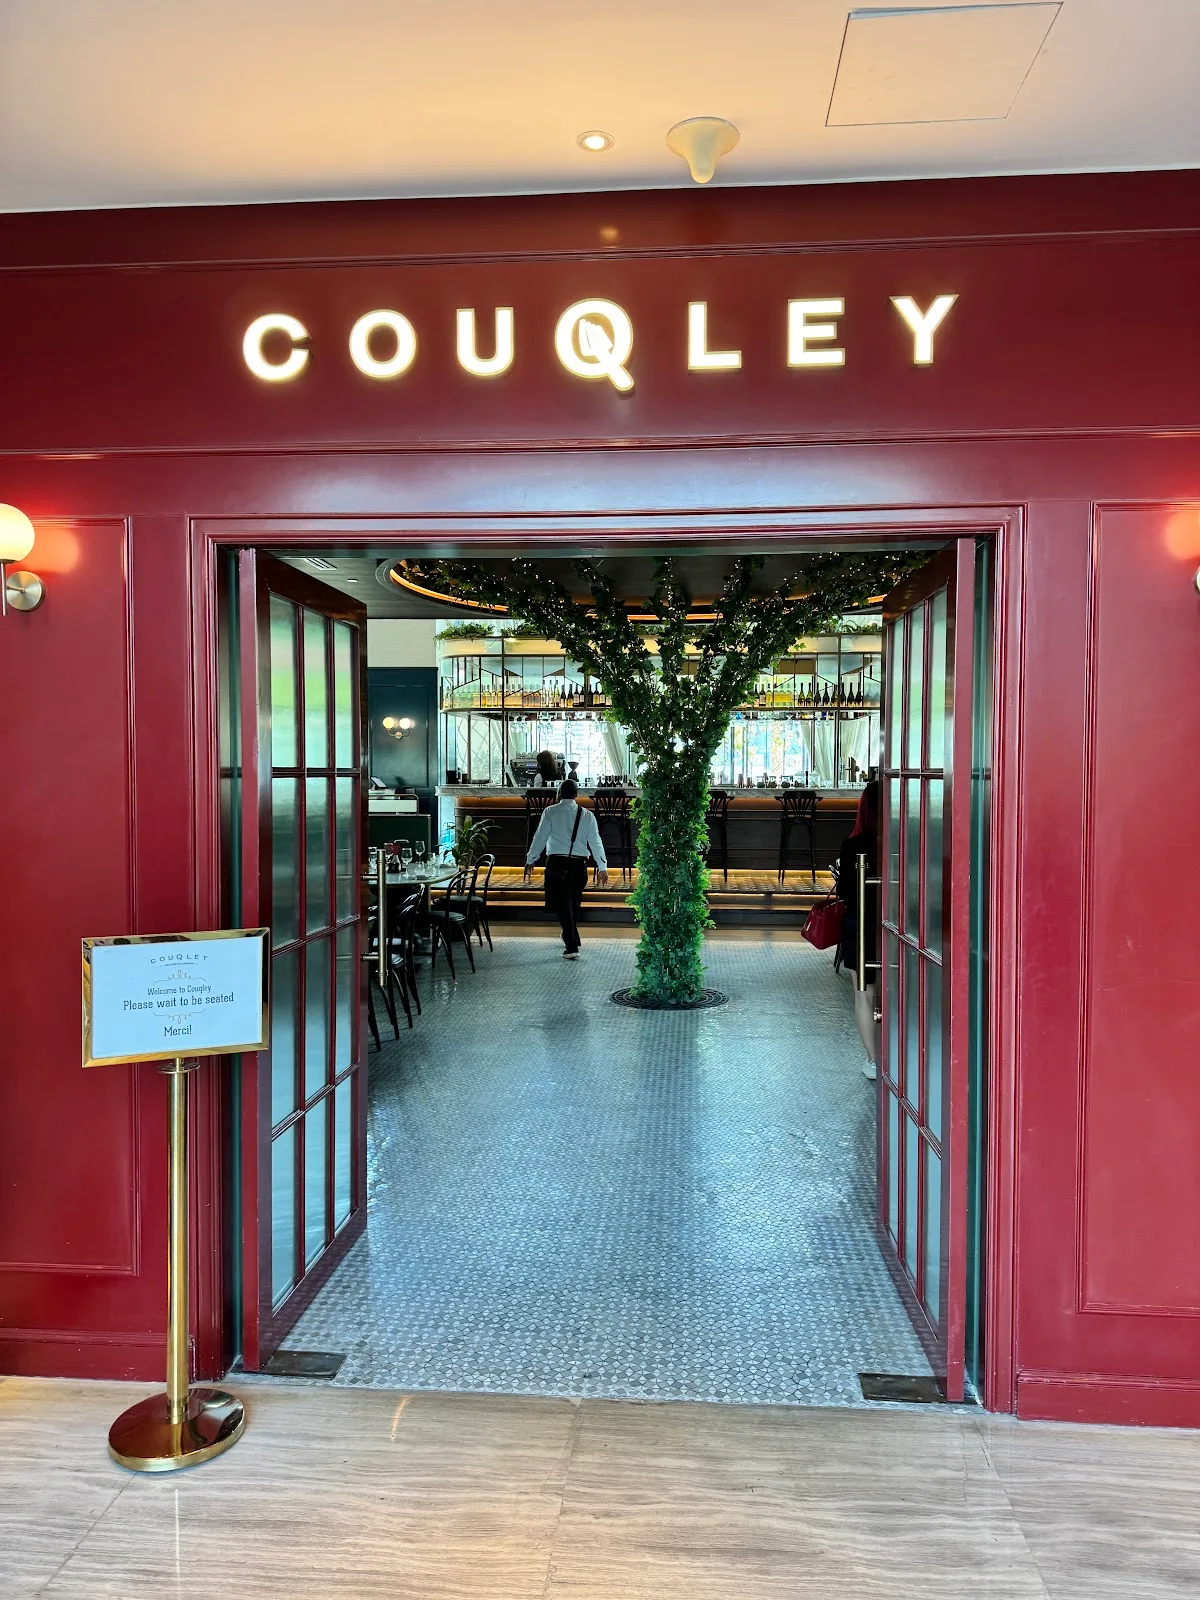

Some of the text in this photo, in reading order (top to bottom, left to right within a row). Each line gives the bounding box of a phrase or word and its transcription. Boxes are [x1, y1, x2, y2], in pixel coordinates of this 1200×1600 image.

[242, 293, 960, 393] COUQLEY
[150, 953, 208, 964] COUQLEY
[147, 987, 177, 996] Welcome
[179, 986, 186, 994] to
[123, 991, 235, 1011] Please wait to be seated
[163, 1024, 193, 1037] Merci!
